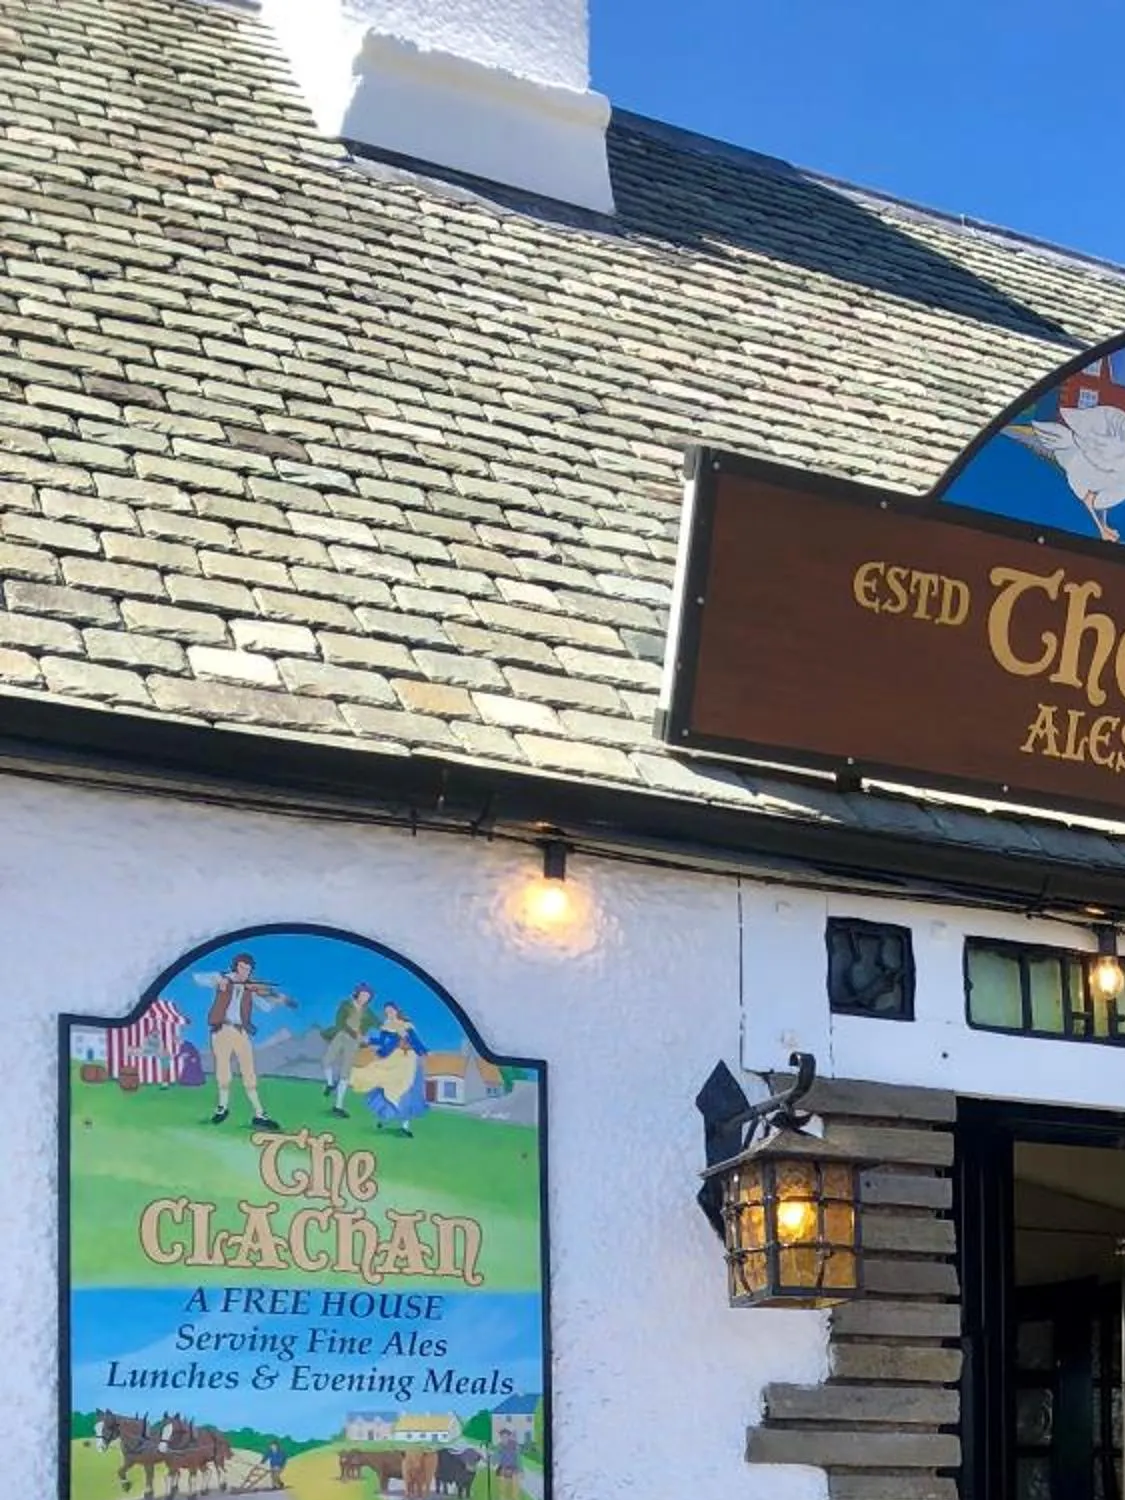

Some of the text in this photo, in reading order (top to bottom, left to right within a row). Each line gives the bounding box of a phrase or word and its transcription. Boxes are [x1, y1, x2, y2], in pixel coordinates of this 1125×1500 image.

[852, 561, 971, 626] ESTD
[250, 1129, 379, 1202] The
[139, 1196, 485, 1287] CLACHAN
[184, 1286, 444, 1321] A FREE HOUSE
[175, 1323, 448, 1362] Serving Fine Ales
[106, 1360, 515, 1402] Lunches & Evening Meals
